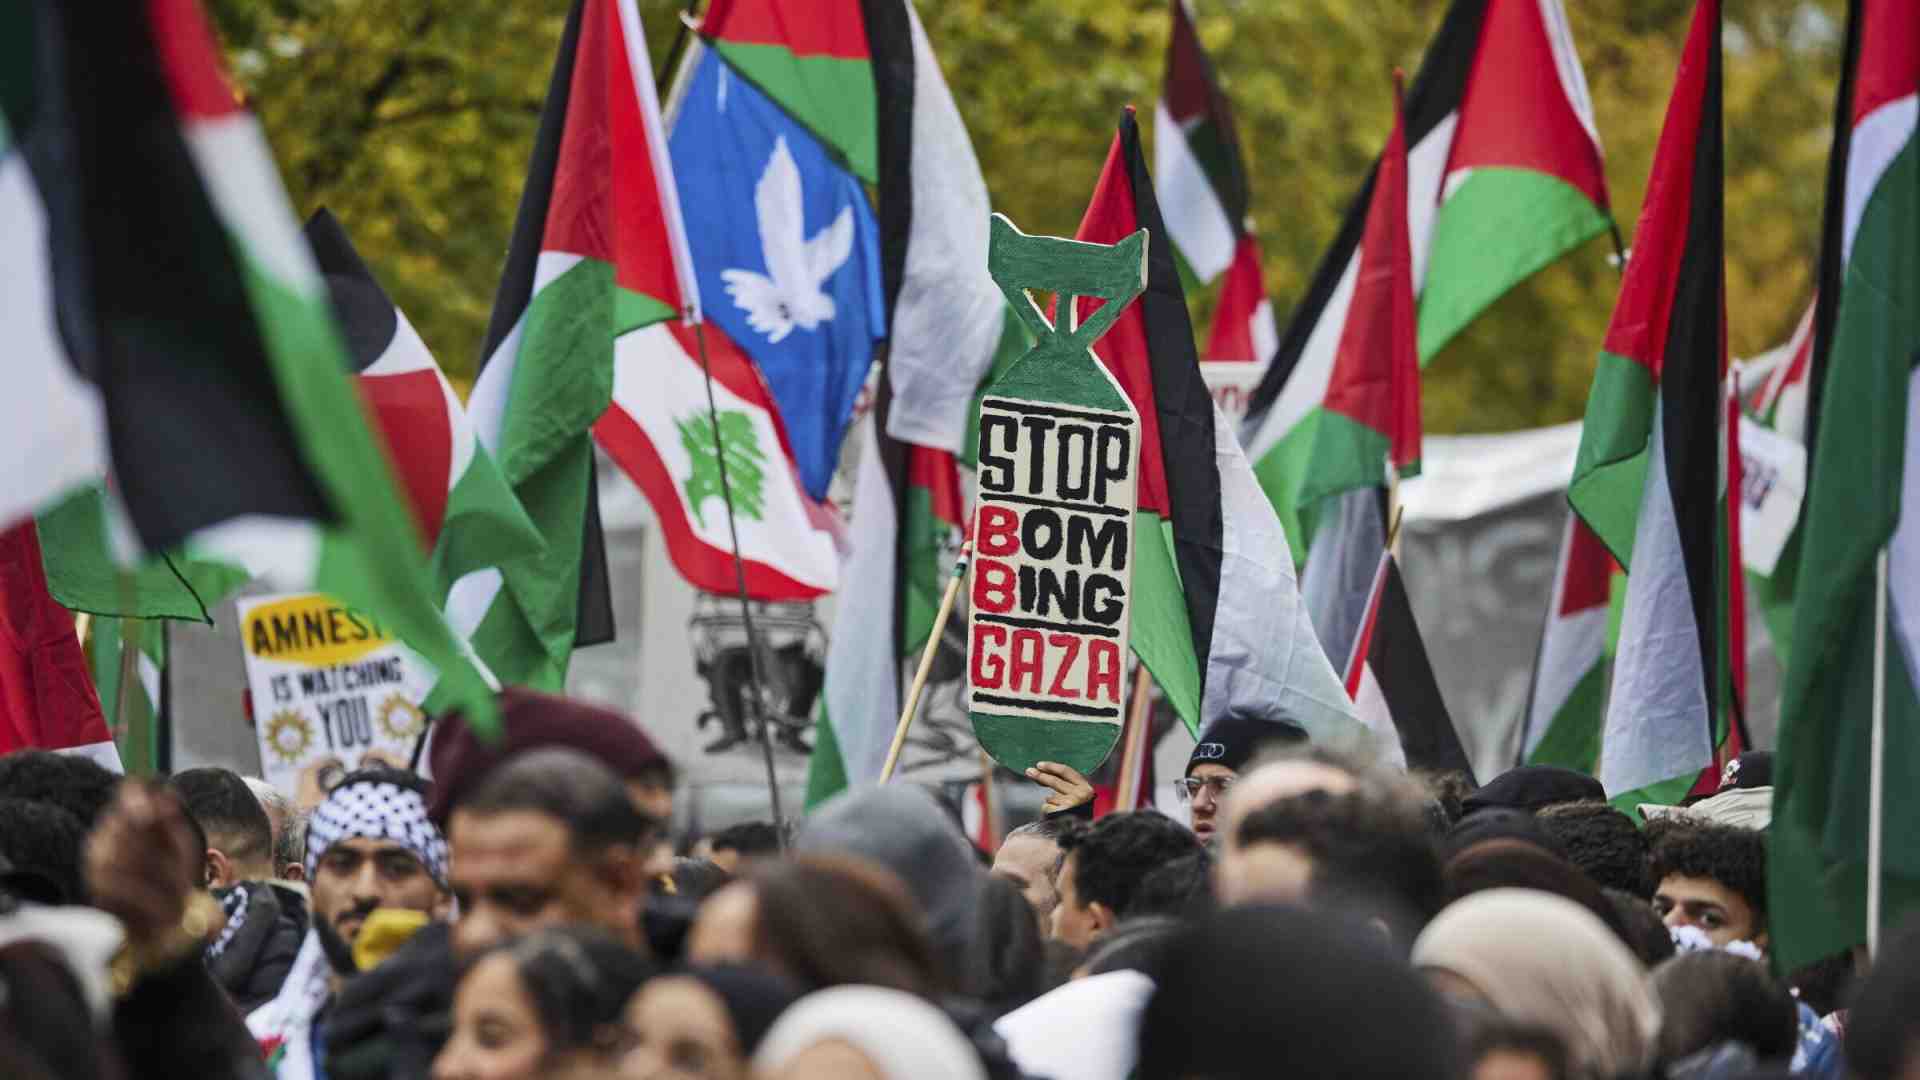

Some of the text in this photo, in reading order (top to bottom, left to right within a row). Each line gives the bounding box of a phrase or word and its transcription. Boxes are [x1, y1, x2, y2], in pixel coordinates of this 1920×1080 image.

[979, 414, 1130, 504] STOP
[976, 505, 1128, 571] BOM
[972, 558, 1126, 626] BING
[270, 655, 403, 702] IS WATCHING
[971, 624, 1121, 704] GAZA
[316, 696, 372, 750] YOU
